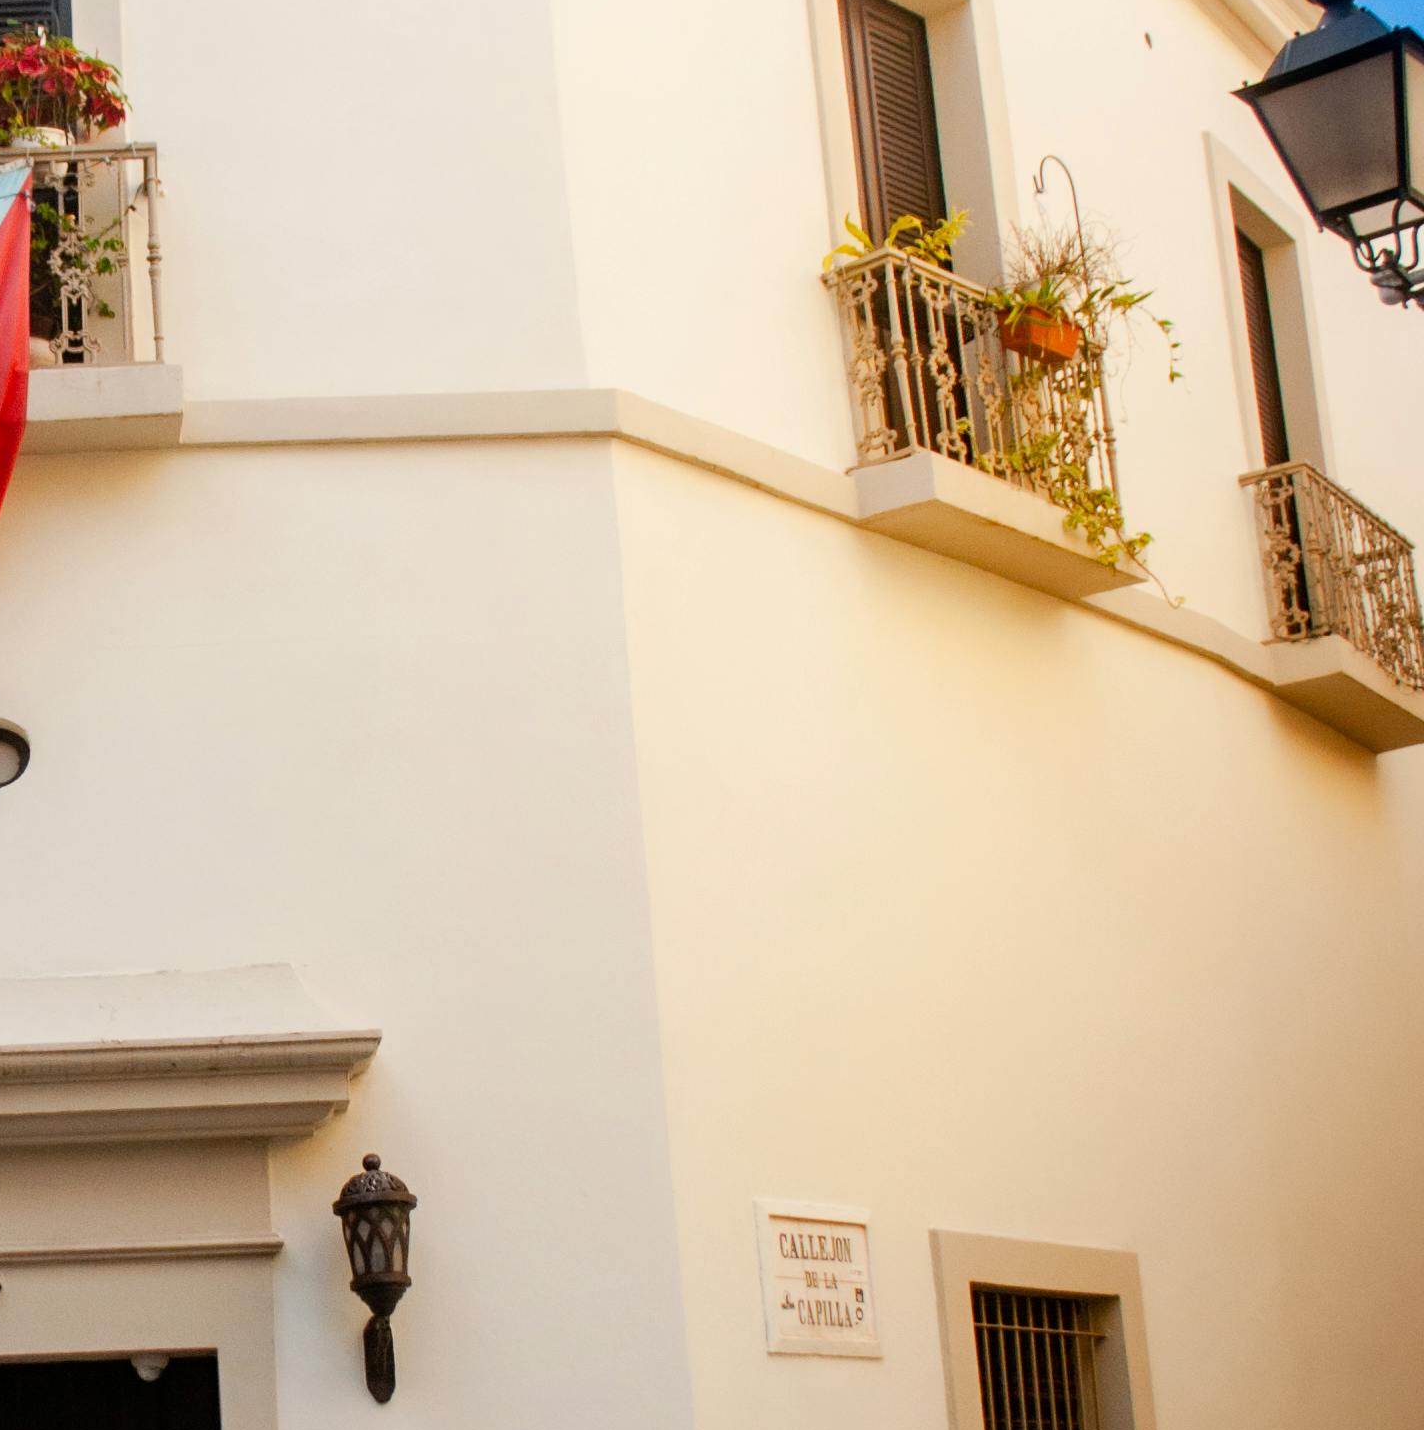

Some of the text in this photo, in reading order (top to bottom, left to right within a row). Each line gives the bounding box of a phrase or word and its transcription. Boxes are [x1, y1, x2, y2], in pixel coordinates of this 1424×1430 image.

[780, 1234, 852, 1262] CALLEJON
[805, 1271, 838, 1289] DE LA
[798, 1299, 853, 1327] CAPILLA
